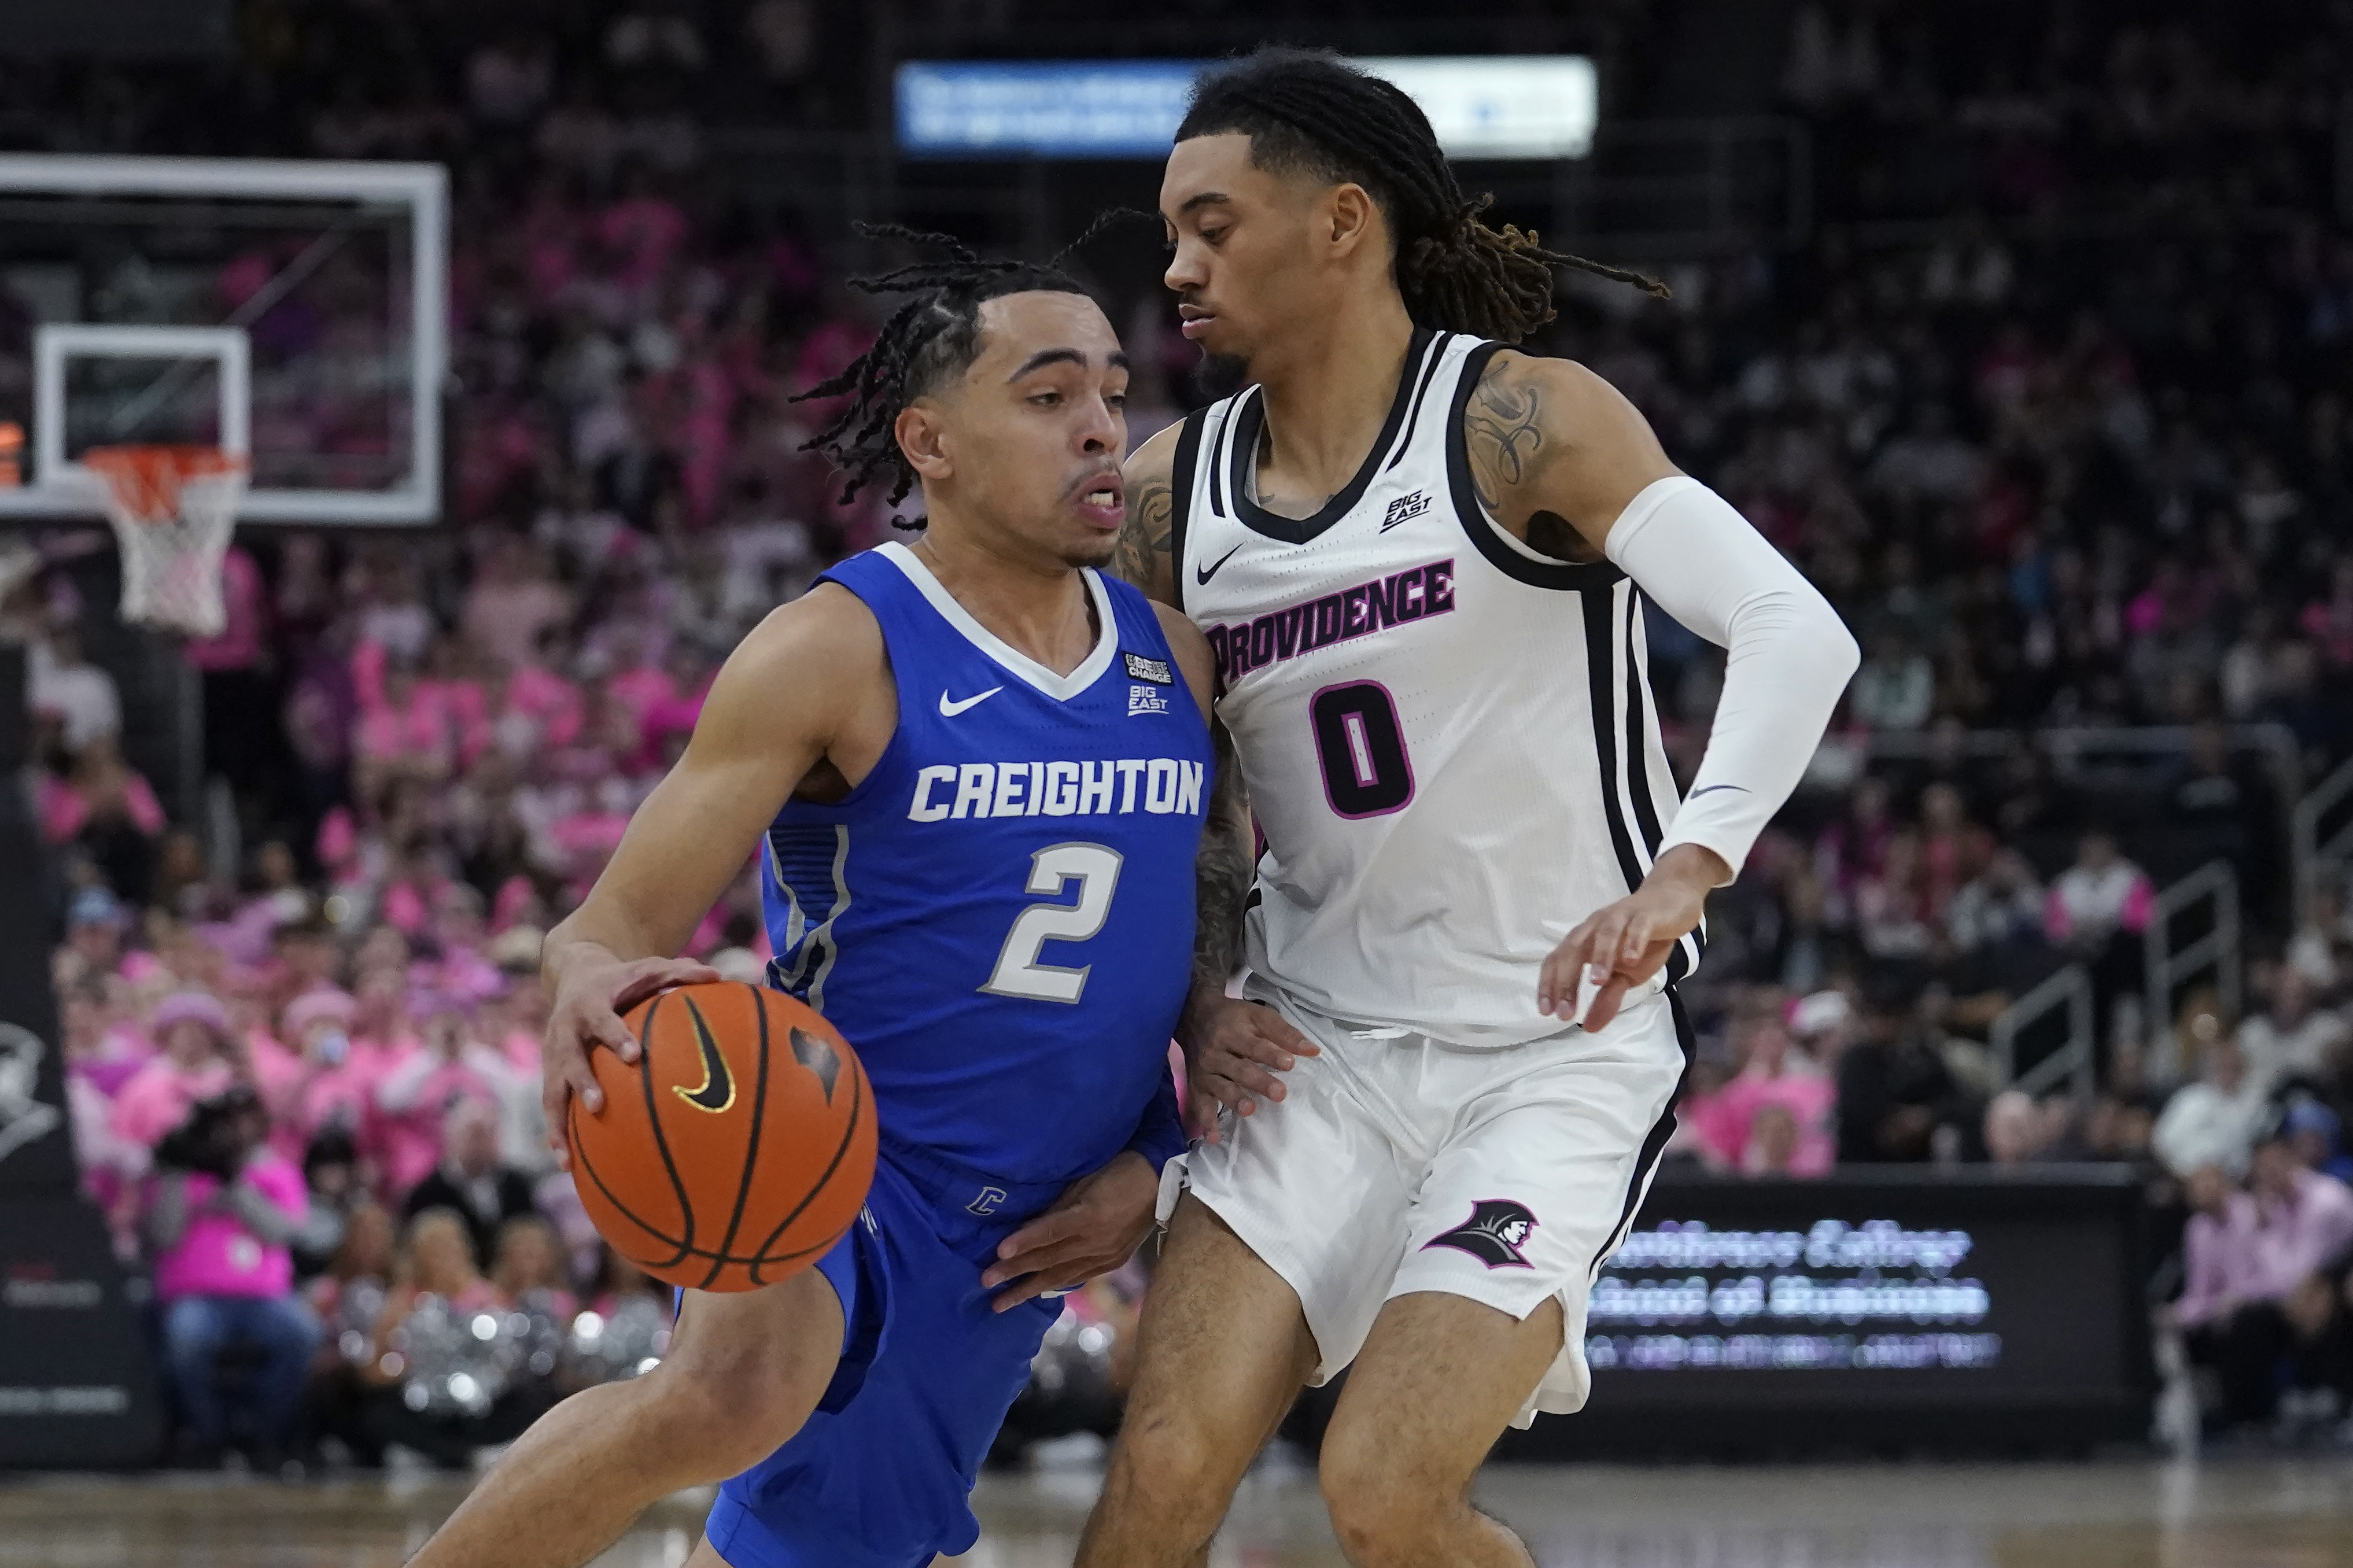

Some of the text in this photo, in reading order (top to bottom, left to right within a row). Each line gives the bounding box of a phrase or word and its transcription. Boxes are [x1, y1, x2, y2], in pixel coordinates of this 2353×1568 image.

[1382, 497, 1433, 526] EAST
[1387, 489, 1423, 514] BIG
[1204, 558, 1455, 683] PROVIDENCE
[1128, 666, 1172, 683] CHANGE
[1128, 698, 1168, 710] EAST
[1130, 685, 1156, 698] BIG
[1309, 679, 1415, 820] 0
[907, 759, 1204, 822] CREIGHTON
[976, 842, 1124, 1005] 2
[965, 1186, 1008, 1216] C
